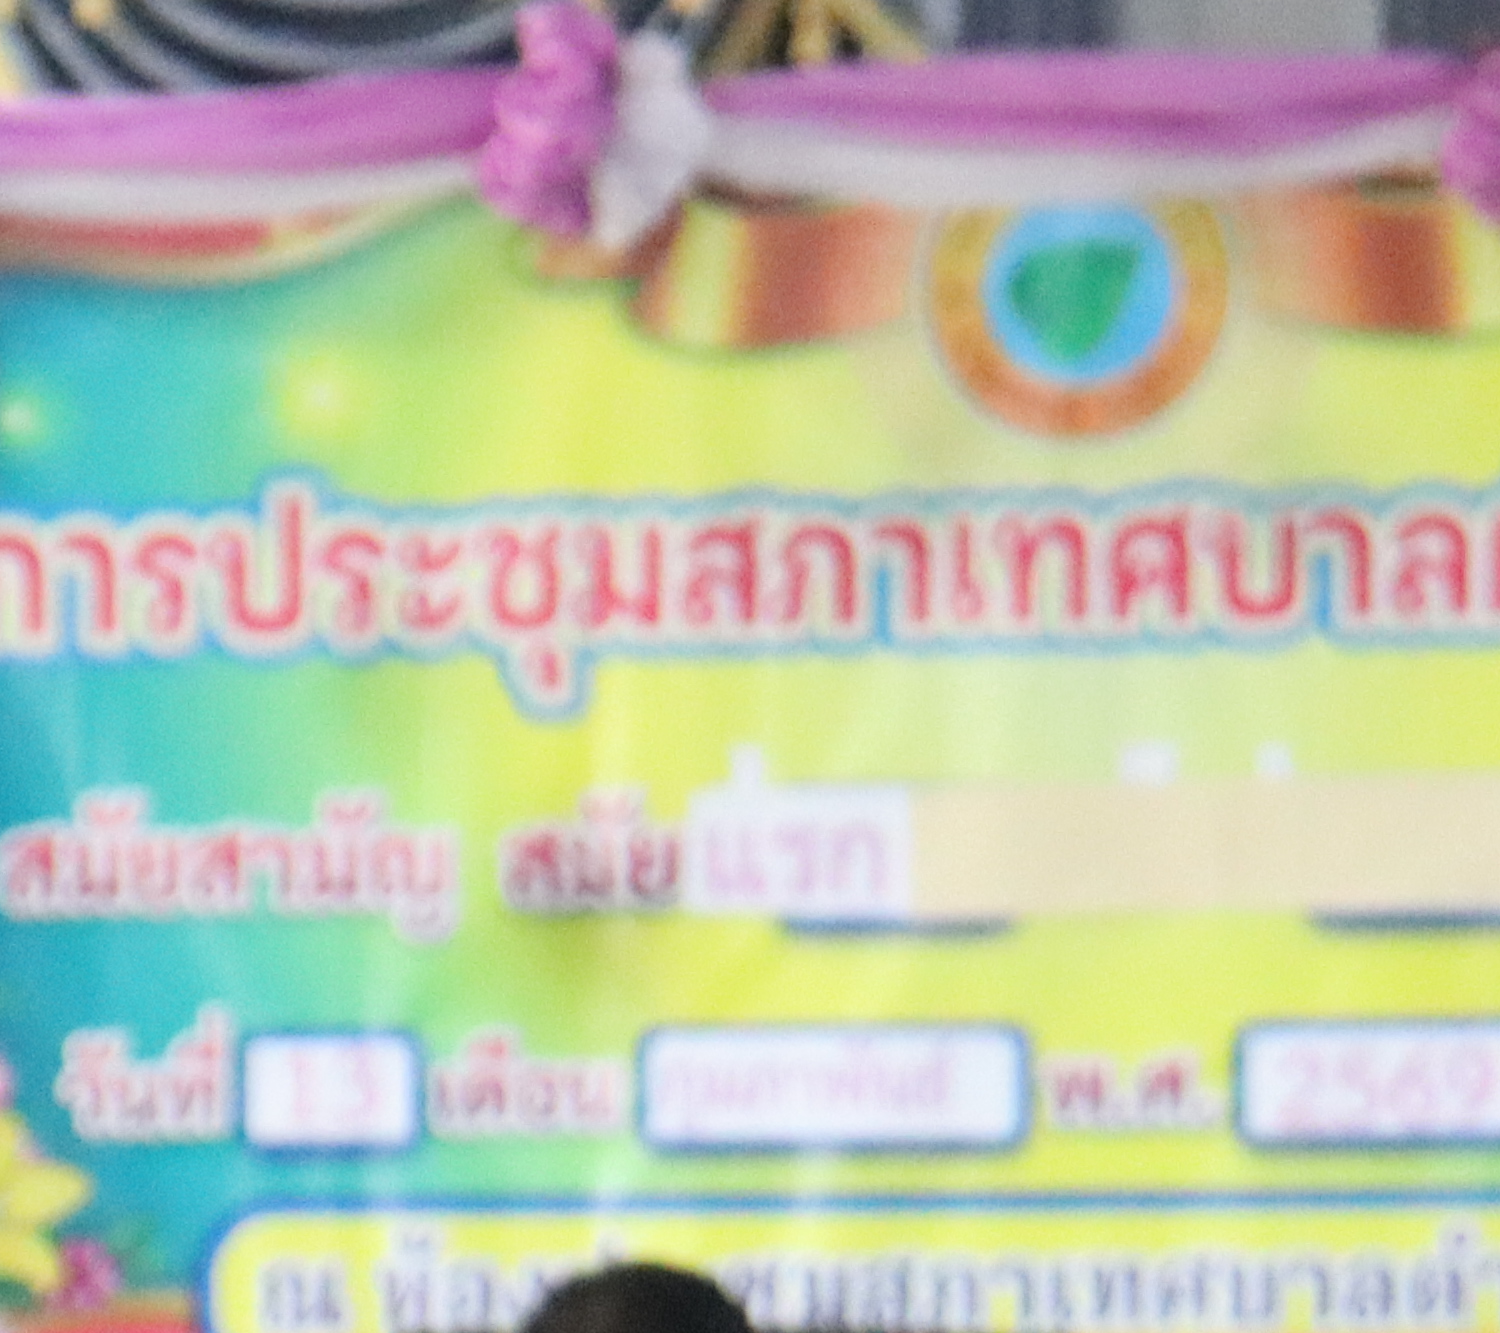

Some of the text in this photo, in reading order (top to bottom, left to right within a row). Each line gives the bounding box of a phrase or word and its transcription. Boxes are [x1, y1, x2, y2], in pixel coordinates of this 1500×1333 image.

[4, 798, 450, 930] สมัยสามัญ
[72, 1012, 228, 1124] วันที่
[432, 1032, 616, 1120] เดือน
[1278, 1042, 1498, 1126] 2569
